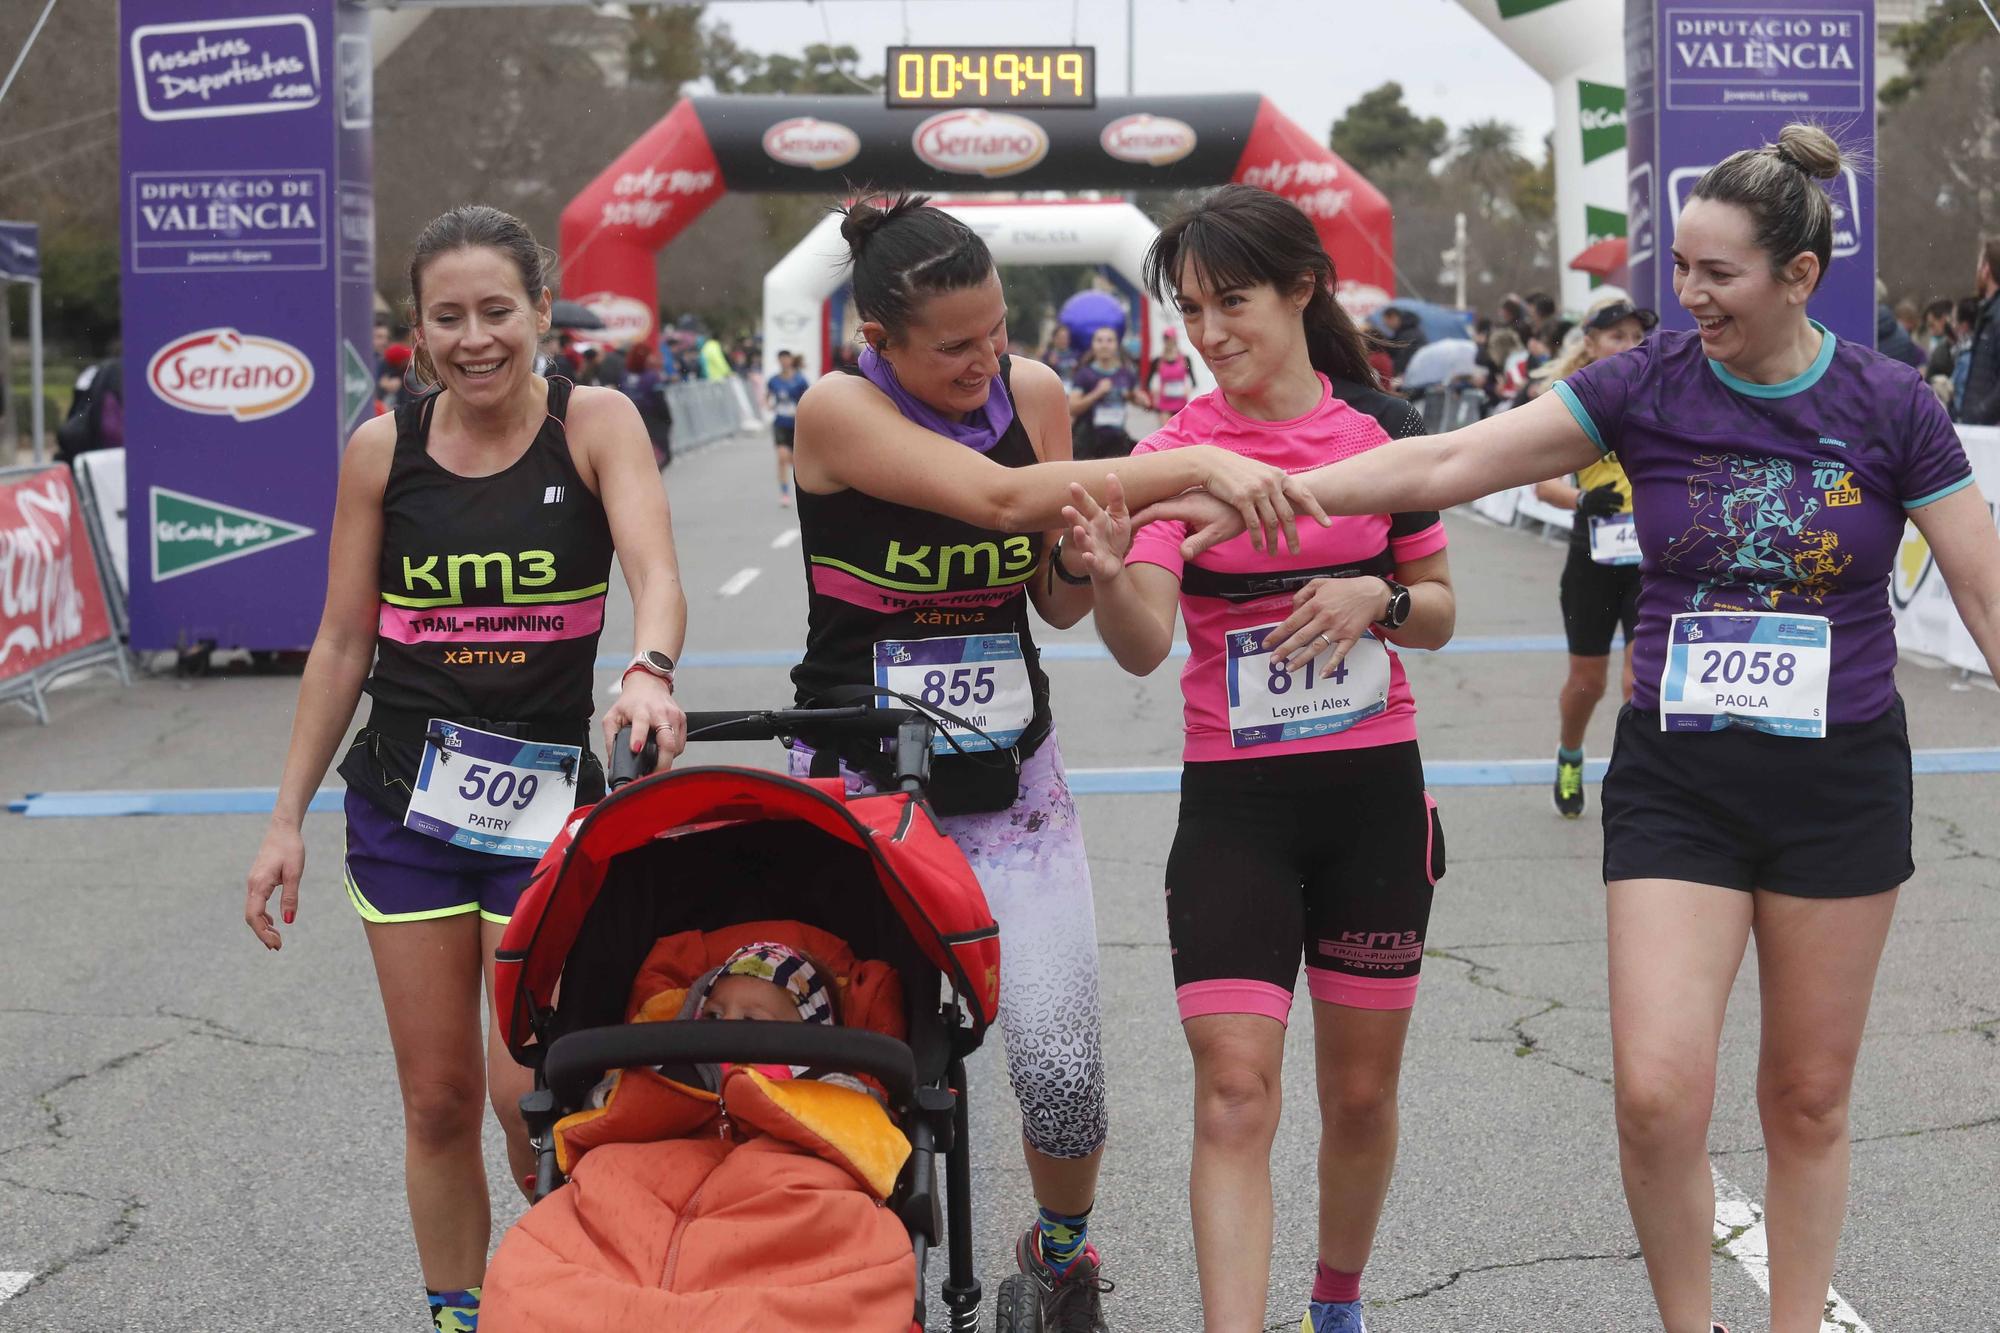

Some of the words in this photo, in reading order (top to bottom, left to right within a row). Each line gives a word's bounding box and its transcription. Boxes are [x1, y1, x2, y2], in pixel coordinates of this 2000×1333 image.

[1677, 18, 1811, 37] DIPUTACIÓ
[1820, 22, 1851, 37] DE
[1676, 38, 1854, 70] VALÈNCIA
[158, 51, 304, 100] Deportistas
[899, 54, 1083, 98] 00:49:49
[932, 124, 1032, 157] Serrano
[141, 179, 273, 199] DIPUTACIÓ
[281, 180, 314, 196] DE
[141, 200, 316, 231] VALÈNCIA
[171, 357, 294, 390] Serrano
[1812, 468, 1854, 490] 10K
[1829, 490, 1858, 505] FEM
[410, 615, 565, 634] TRAIL-RUNNING
[1700, 650, 1796, 686] 2058
[921, 667, 995, 707] 855
[1272, 702, 1310, 718] Leyre
[1313, 701, 1317, 712] i
[1321, 697, 1350, 711] Alex
[1715, 694, 1768, 708] PAOLA
[1813, 709, 1819, 717] S
[458, 763, 538, 810] 509
[468, 813, 511, 831] PATRY
